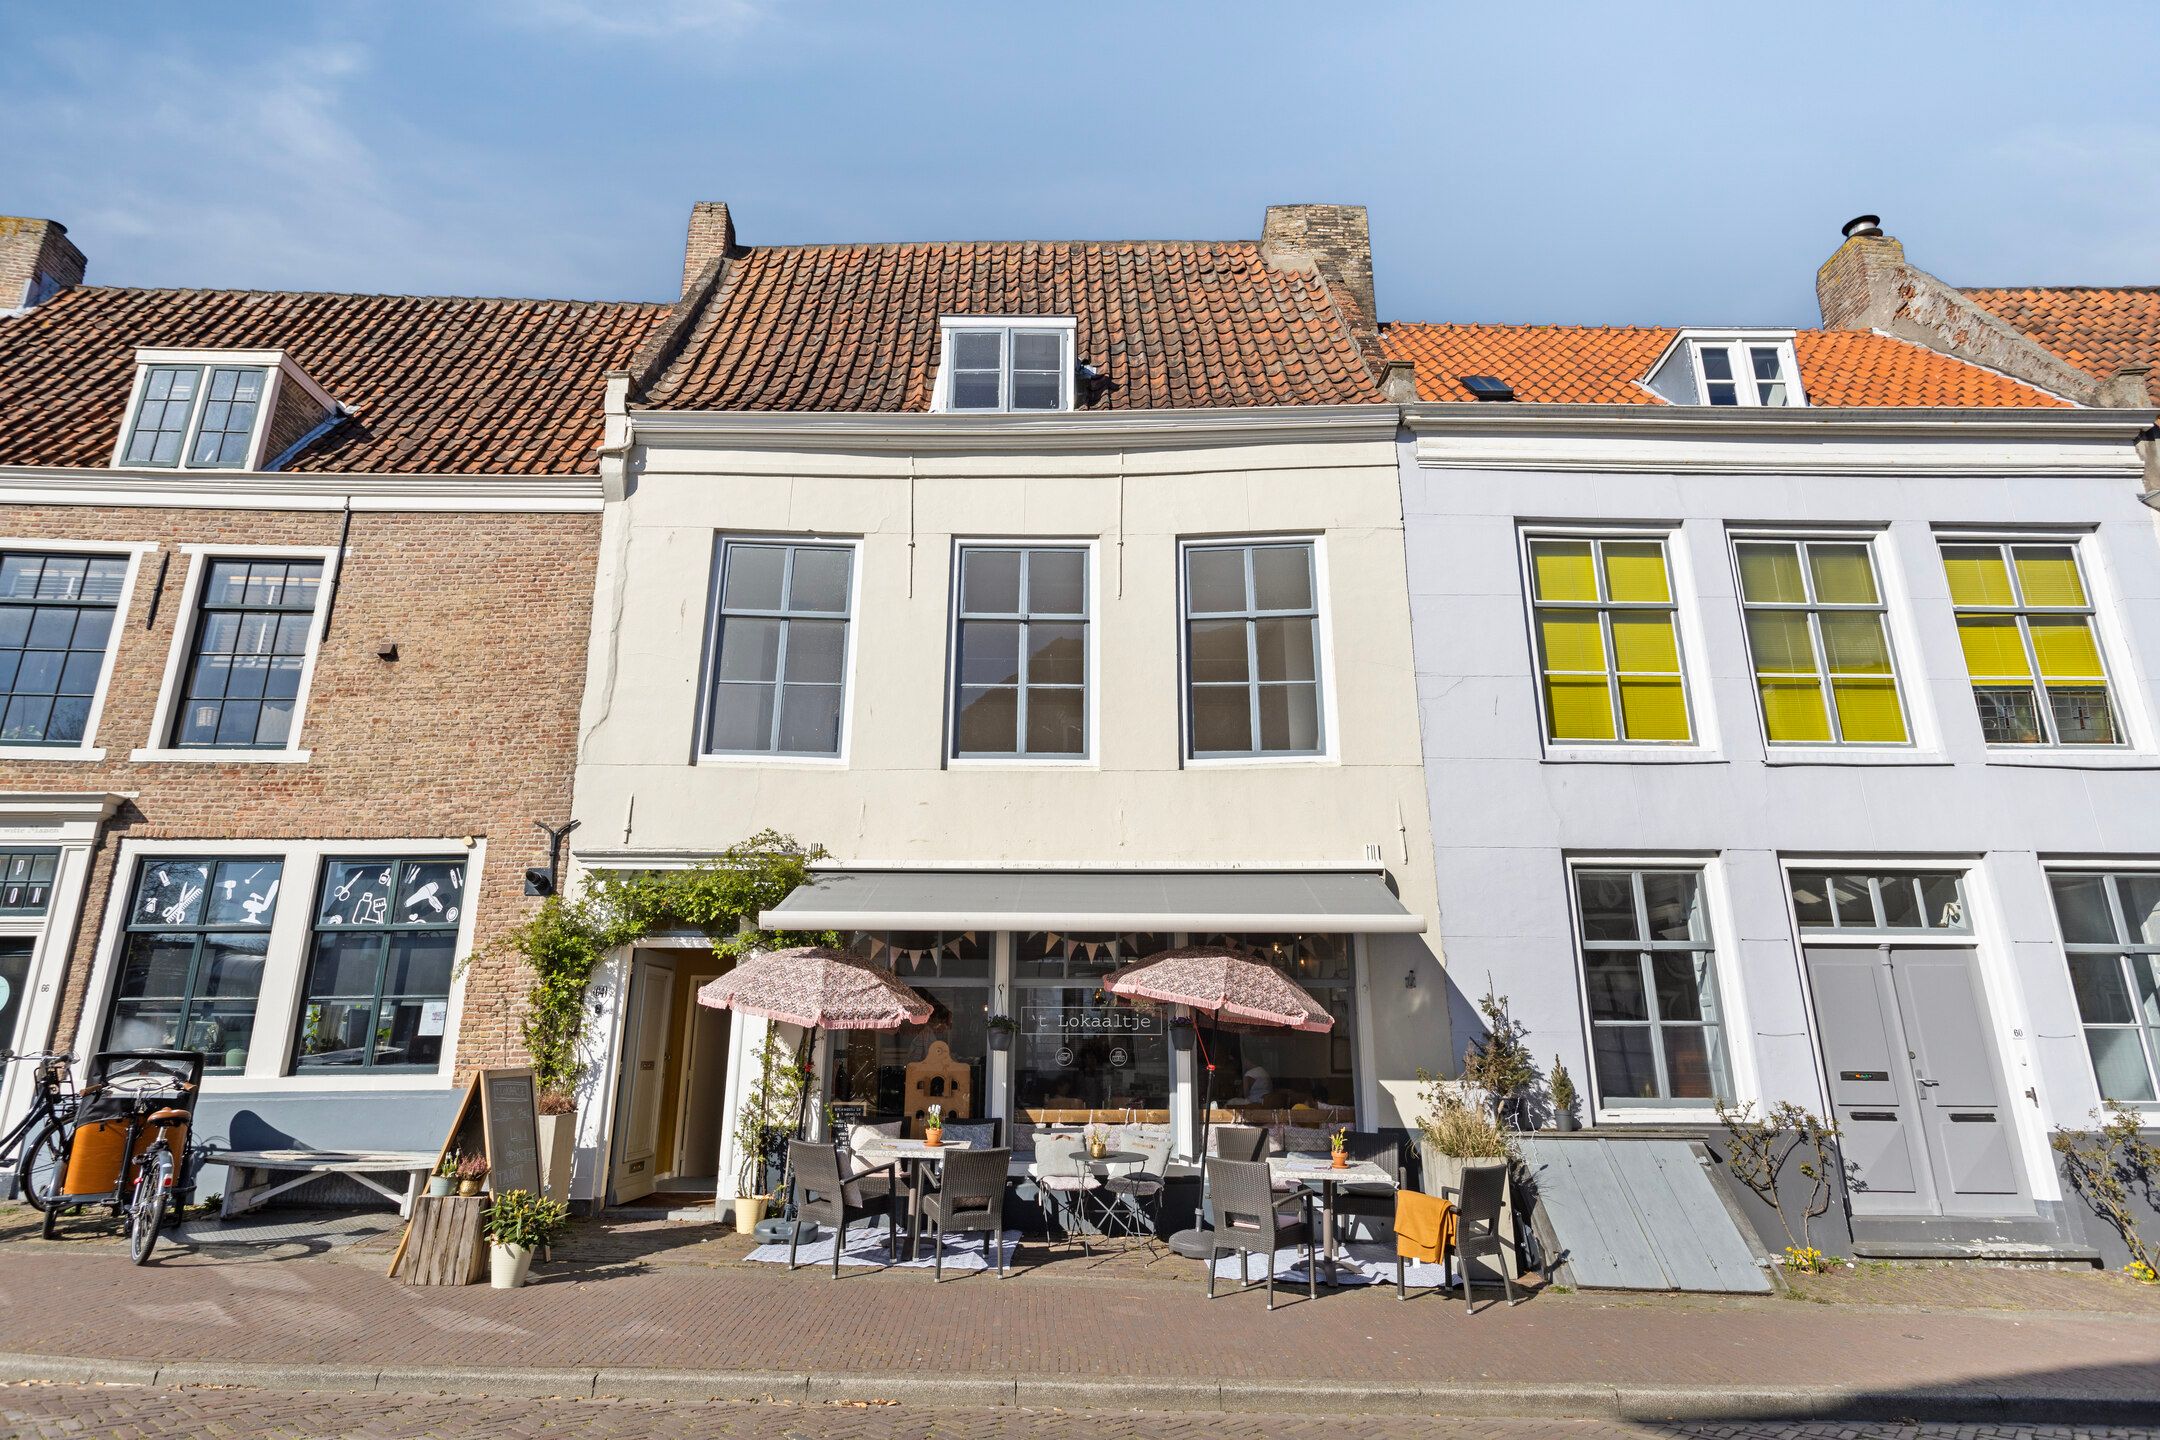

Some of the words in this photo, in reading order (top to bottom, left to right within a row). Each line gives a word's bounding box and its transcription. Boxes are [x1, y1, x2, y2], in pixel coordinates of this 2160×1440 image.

[41, 984, 50, 993] 66
[1058, 1014, 1151, 1031] Lokaaltje
[2013, 1028, 2024, 1038] 60
